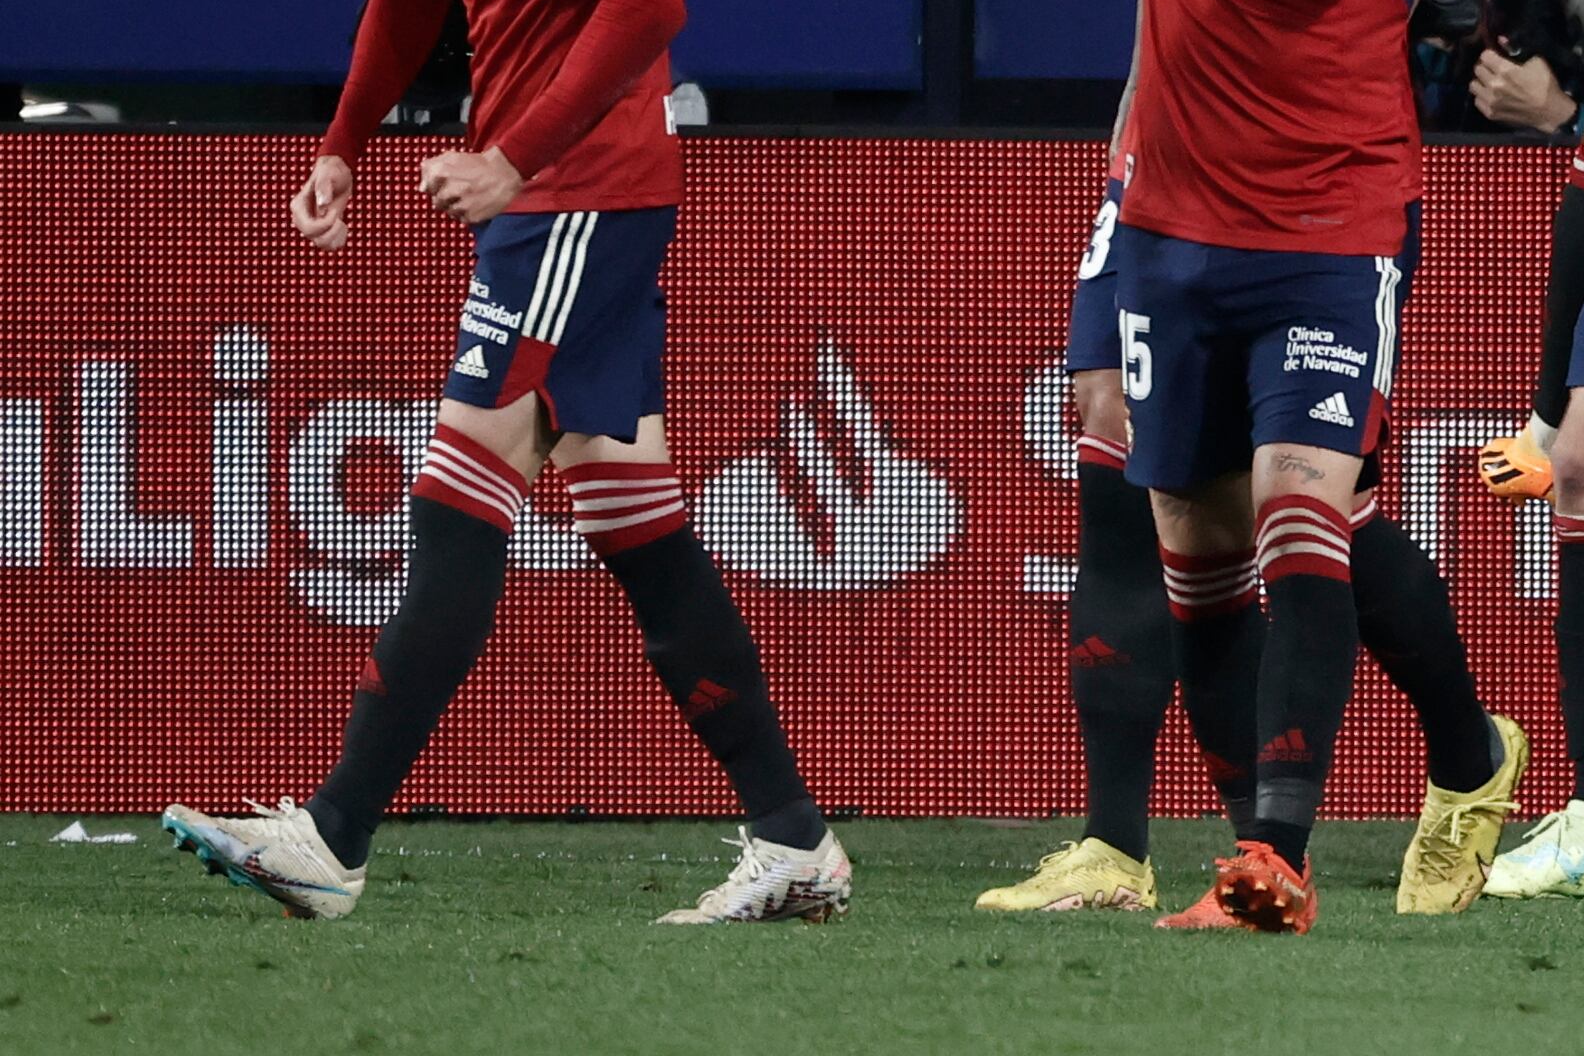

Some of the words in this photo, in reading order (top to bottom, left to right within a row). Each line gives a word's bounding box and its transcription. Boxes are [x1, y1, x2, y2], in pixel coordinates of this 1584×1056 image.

[1286, 343, 1368, 366] Universidad
[1284, 358, 1299, 372] de
[1302, 356, 1360, 378] Navarra
[1308, 408, 1355, 428] adidas
